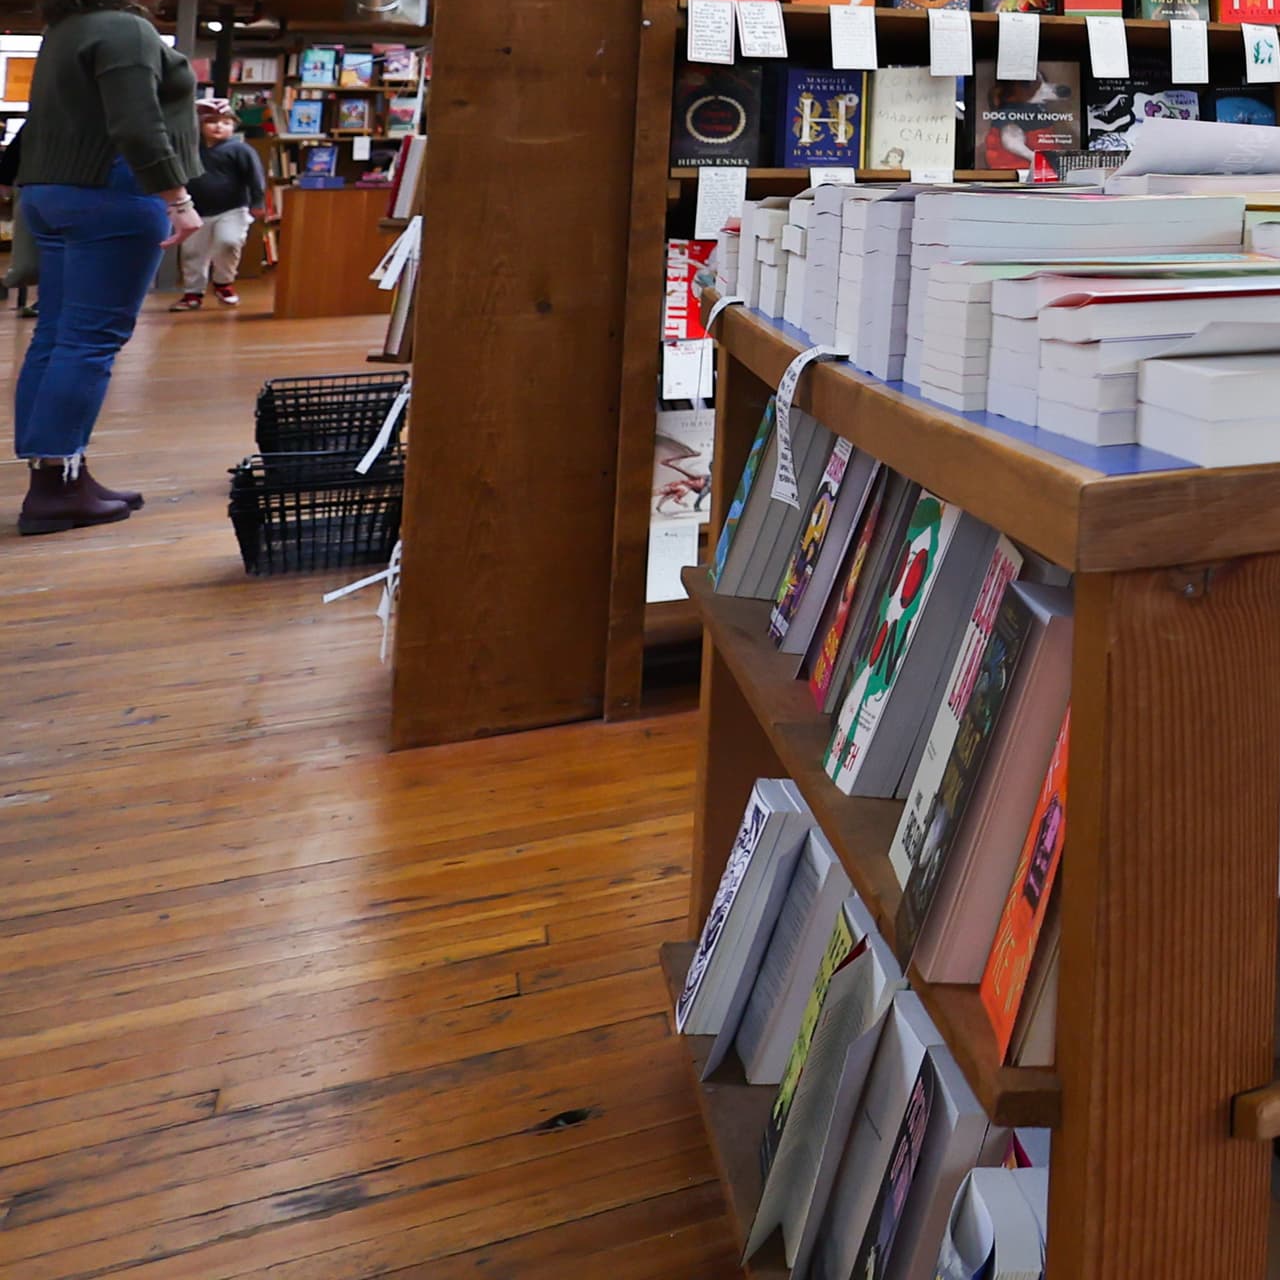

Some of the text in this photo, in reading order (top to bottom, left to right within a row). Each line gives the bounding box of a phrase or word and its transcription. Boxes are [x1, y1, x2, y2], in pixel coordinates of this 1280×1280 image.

[982, 111, 1073, 121] DOG ONLY KNOWS
[677, 158, 750, 167] HIRON ENNES
